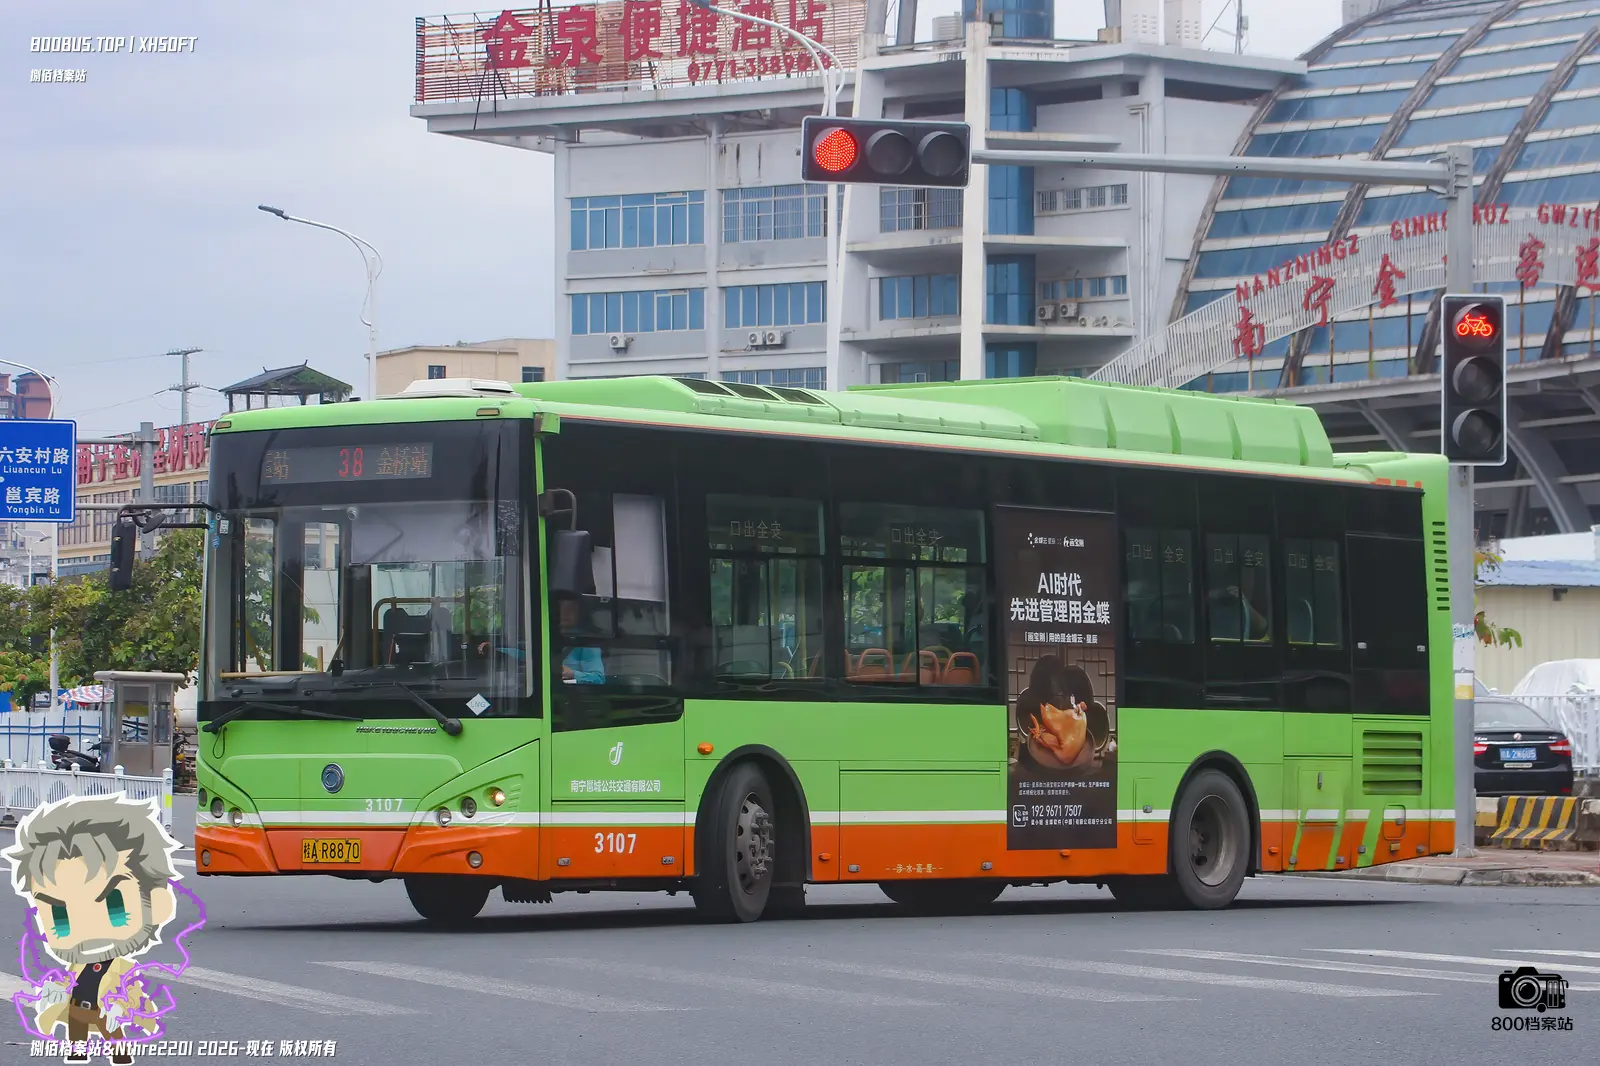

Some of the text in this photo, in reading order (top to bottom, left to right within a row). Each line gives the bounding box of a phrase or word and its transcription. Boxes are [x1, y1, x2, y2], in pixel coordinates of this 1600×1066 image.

[482, 0, 826, 68] 金泉便捷酒店
[1235, 233, 1360, 303] NANZNINGZ
[1232, 232, 1600, 359] 南宁金客运
[0, 447, 70, 465] 六安村路
[338, 447, 363, 477] 38
[376, 446, 429, 476] 金桥站
[3, 466, 62, 474] Liuancun Lu
[5, 486, 61, 505] 邕宾路
[6, 505, 60, 515] Yongbin Lu
[1037, 572, 1082, 597] AI时代
[1010, 597, 1111, 625] 先进管理用金蝶
[470, 700, 487, 708] LNG
[571, 779, 661, 793] 南宁邕城公共交通有限公司
[365, 798, 403, 812] 3107
[1031, 805, 1044, 817] 192
[1045, 805, 1062, 817] 9671
[1065, 805, 1082, 817] 7507
[594, 832, 637, 854] 3107
